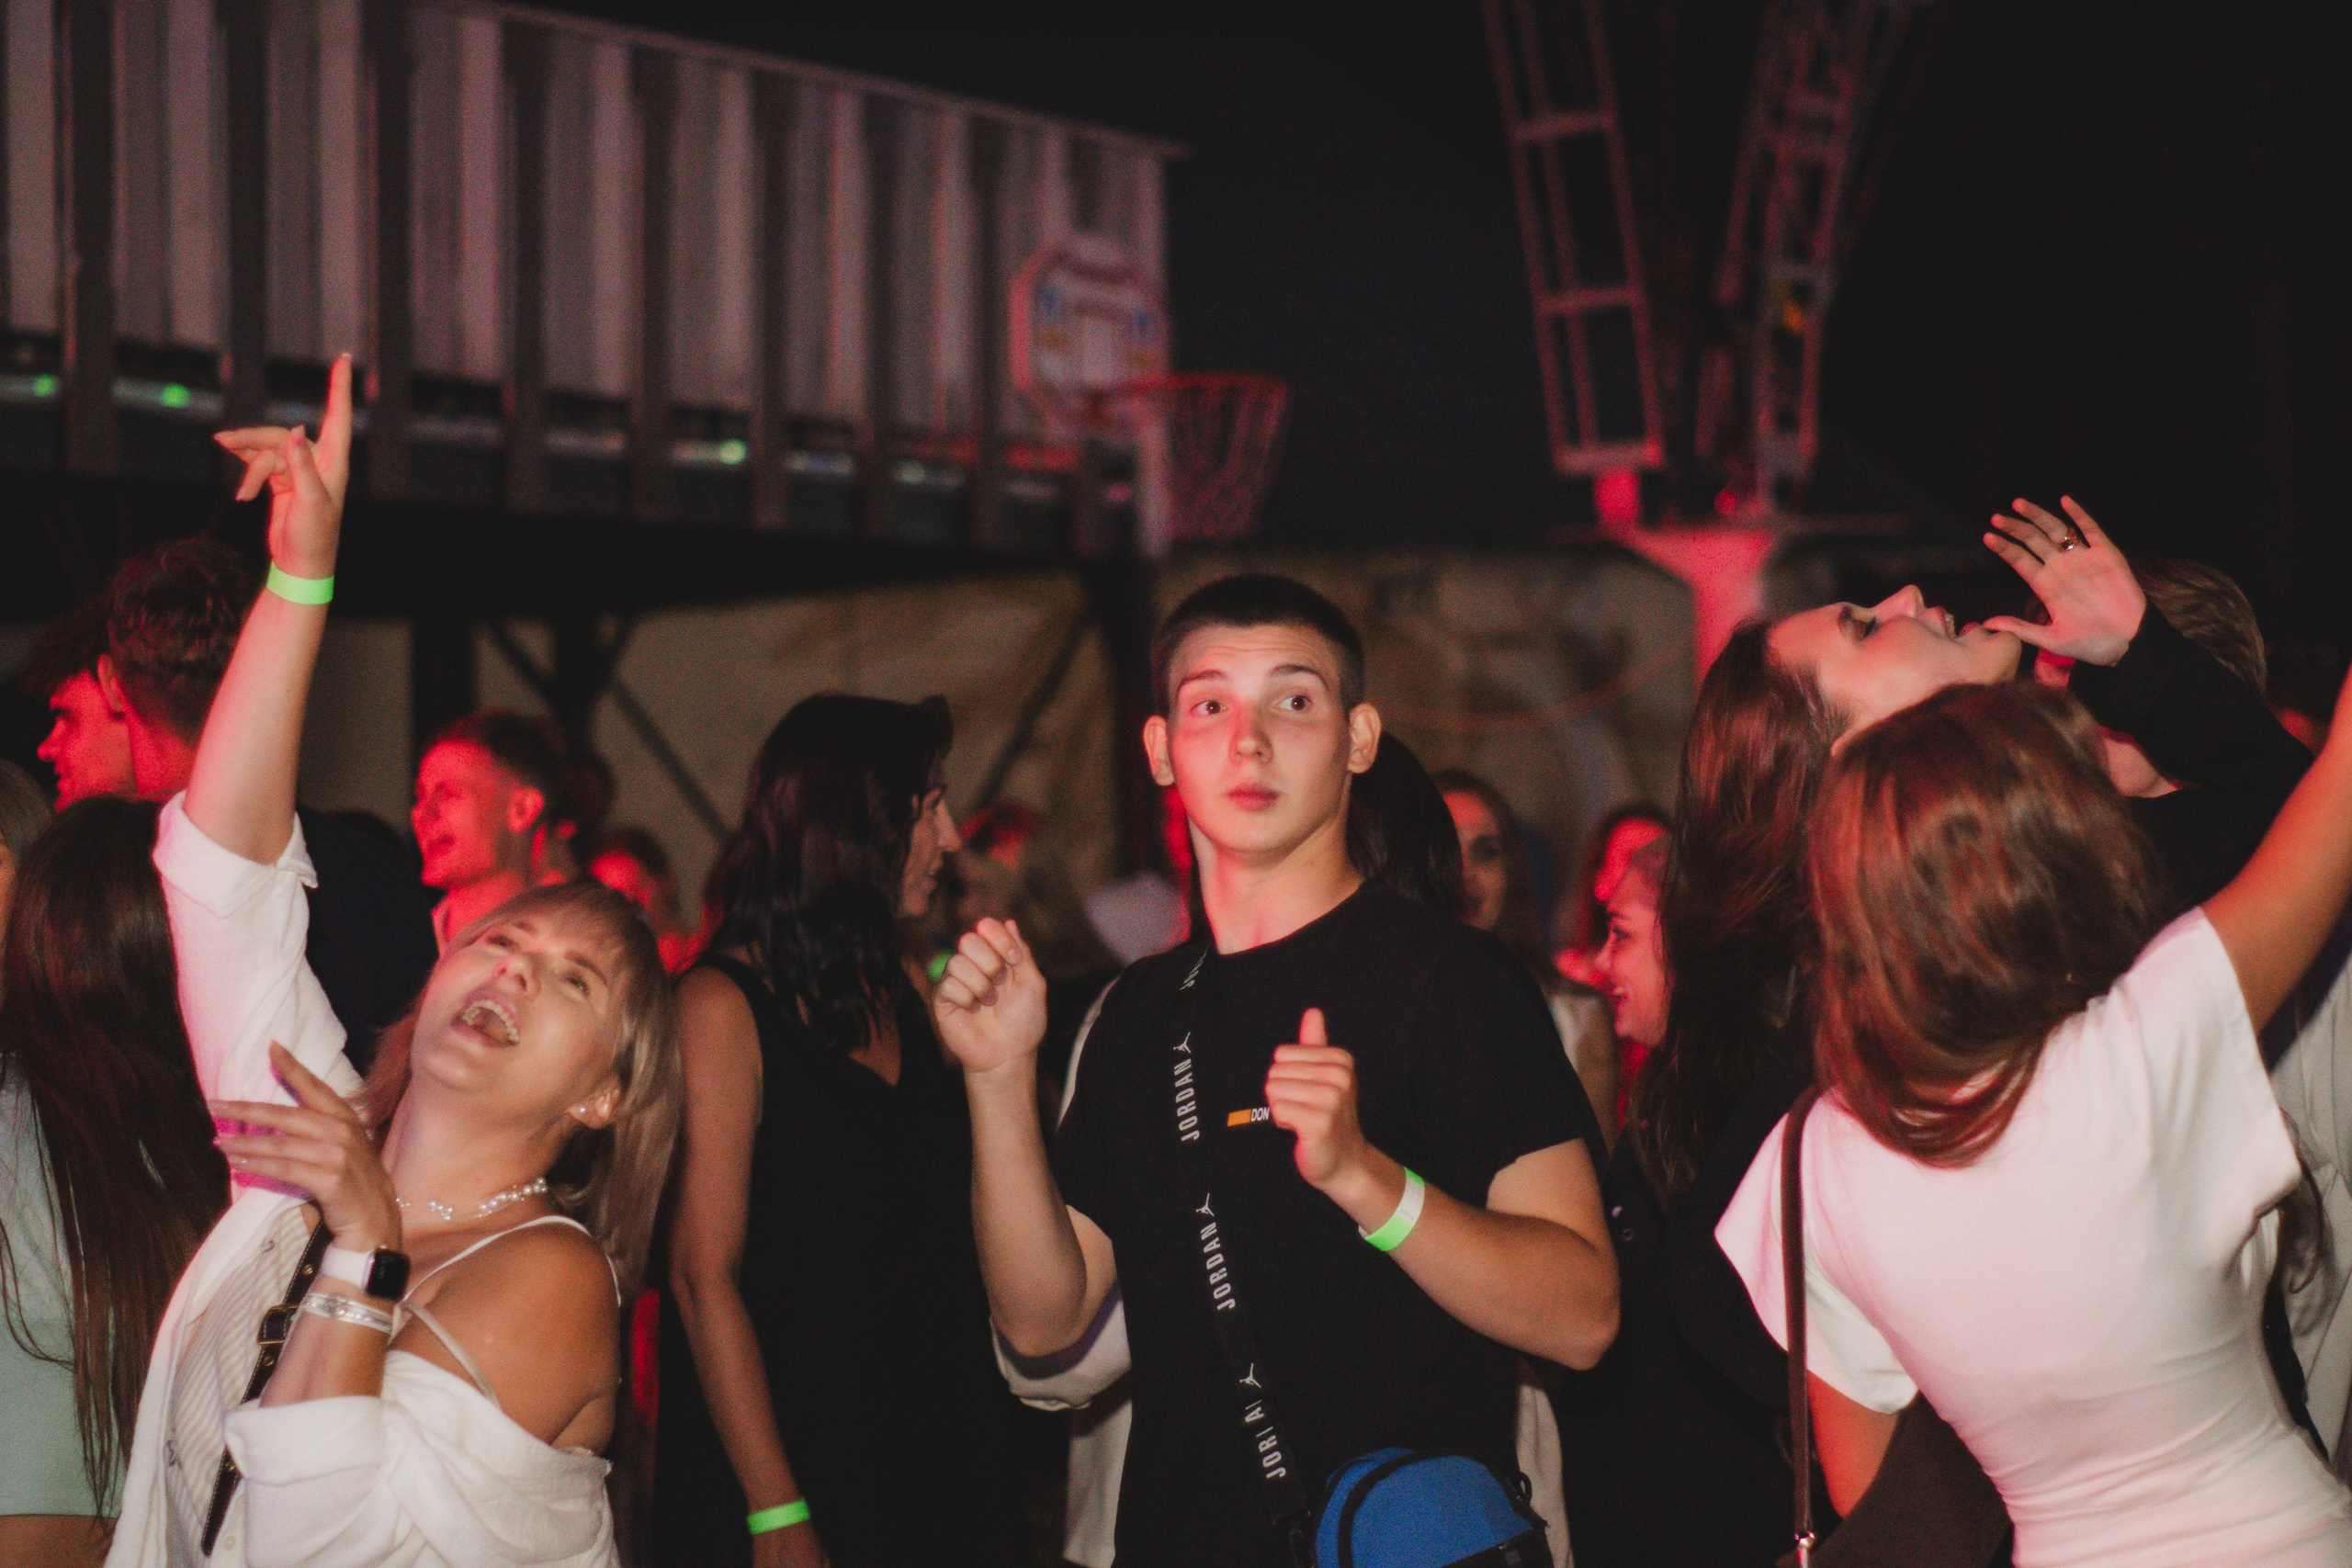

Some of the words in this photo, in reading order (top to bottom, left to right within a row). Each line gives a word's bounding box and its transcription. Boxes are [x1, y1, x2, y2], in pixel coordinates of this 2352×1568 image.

[1174, 1058, 1200, 1141] JORDAN
[1200, 1223, 1235, 1310] JORDAN
[1245, 1400, 1286, 1479] JORA
